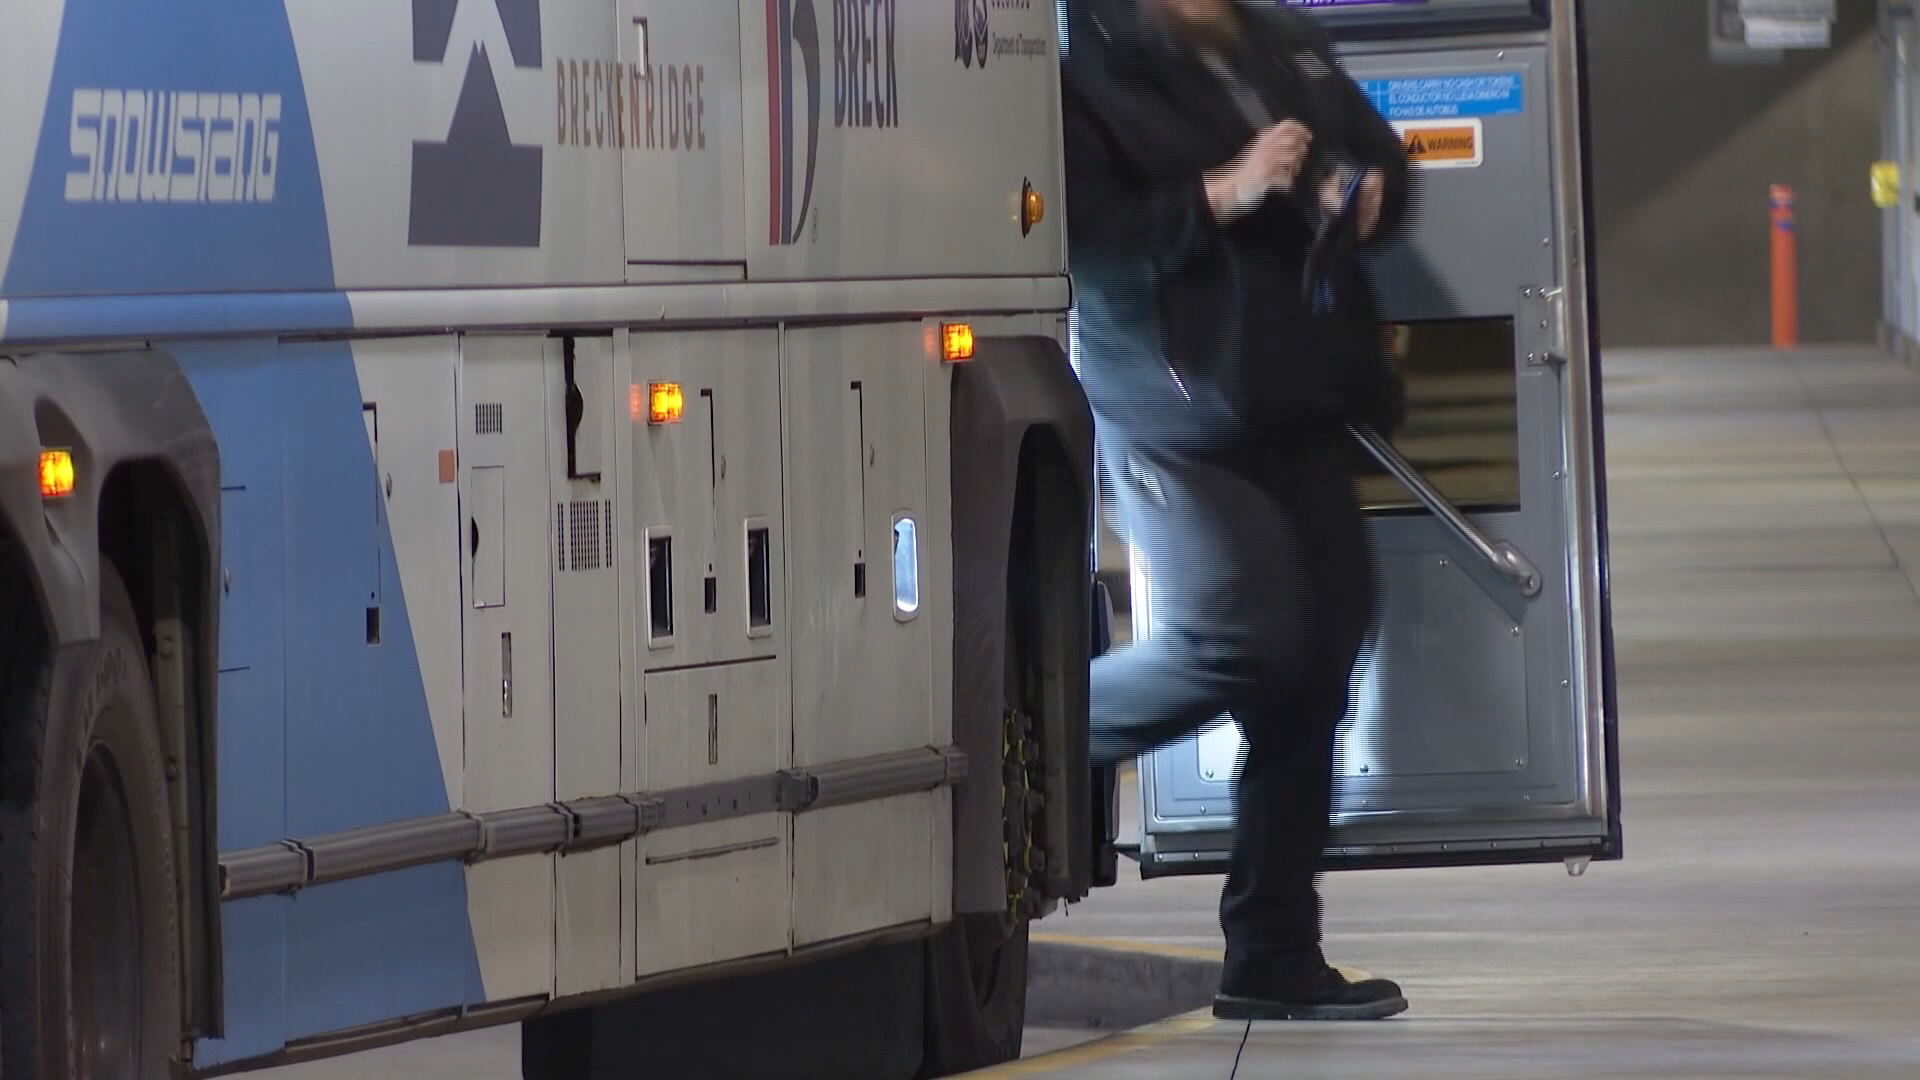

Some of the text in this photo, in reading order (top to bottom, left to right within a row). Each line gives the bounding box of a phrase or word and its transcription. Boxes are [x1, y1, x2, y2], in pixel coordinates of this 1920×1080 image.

[556, 57, 706, 151] BRECKENRIDGE
[833, 0, 898, 128] BRECK
[1427, 136, 1473, 150] WARNING
